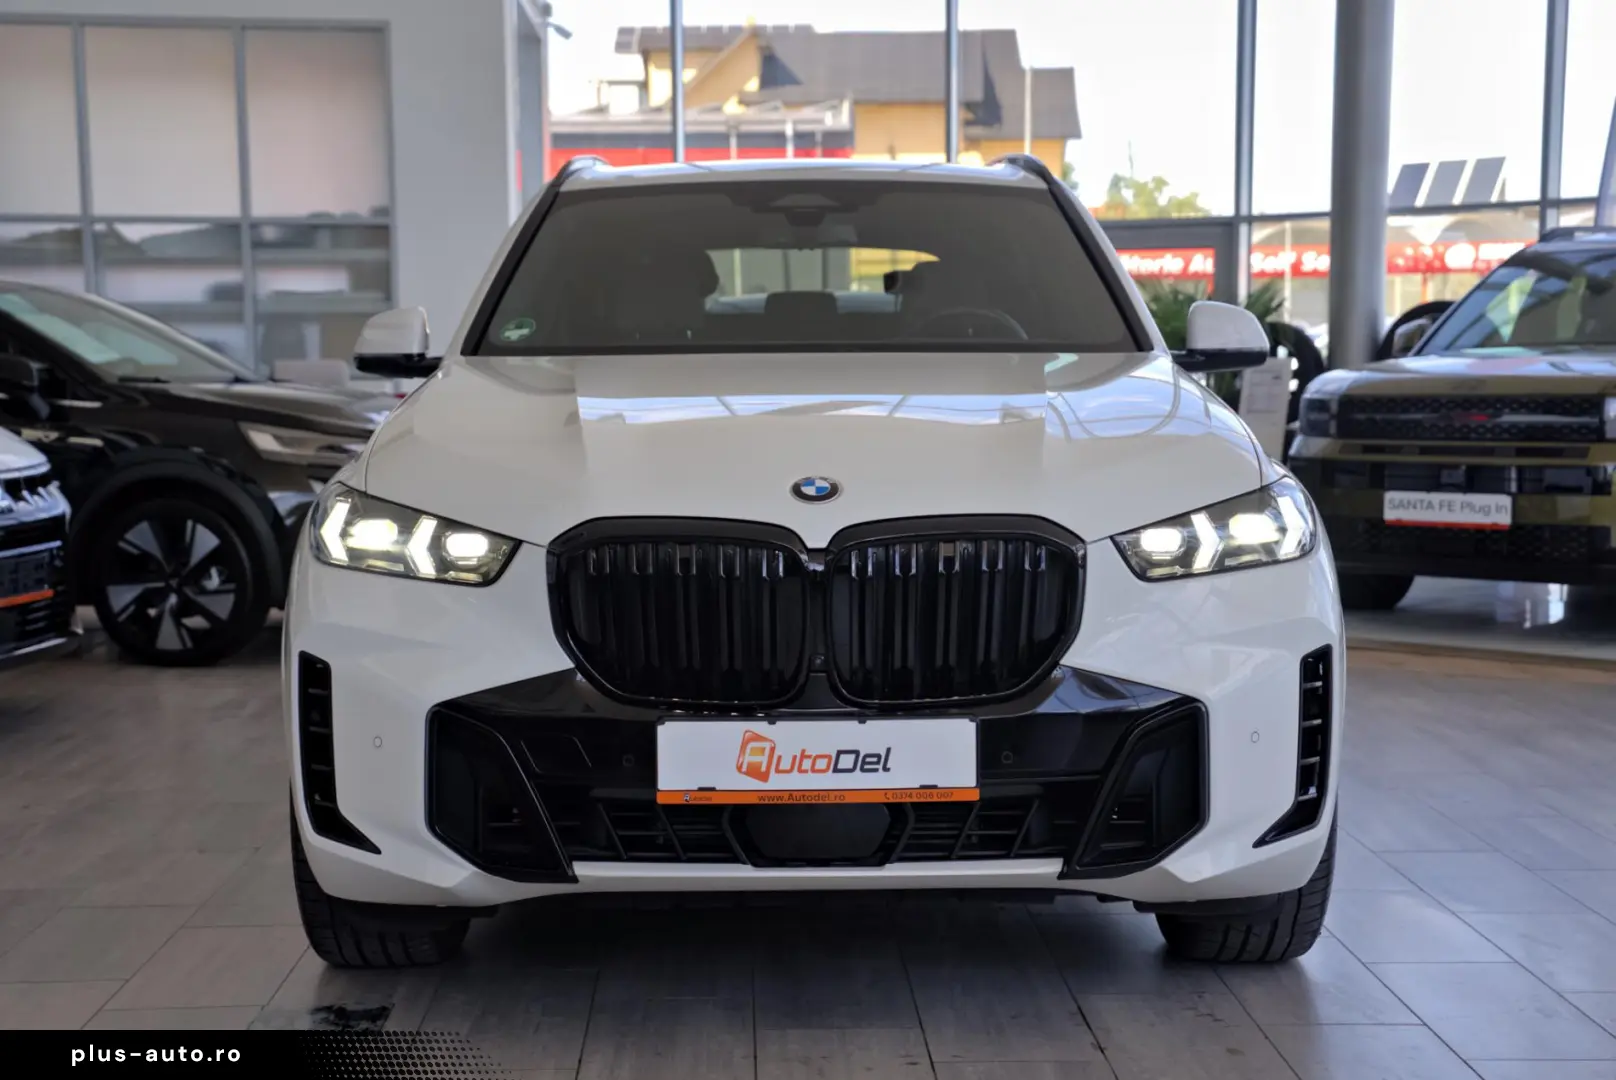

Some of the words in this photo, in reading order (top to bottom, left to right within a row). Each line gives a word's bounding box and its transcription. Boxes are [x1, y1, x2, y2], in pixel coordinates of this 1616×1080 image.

[1387, 497, 1435, 511] SANTA
[1439, 499, 1456, 512] FE
[1460, 500, 1491, 516] Plug
[738, 735, 892, 778] AutoDel
[757, 792, 846, 803] www.Autodel.ro
